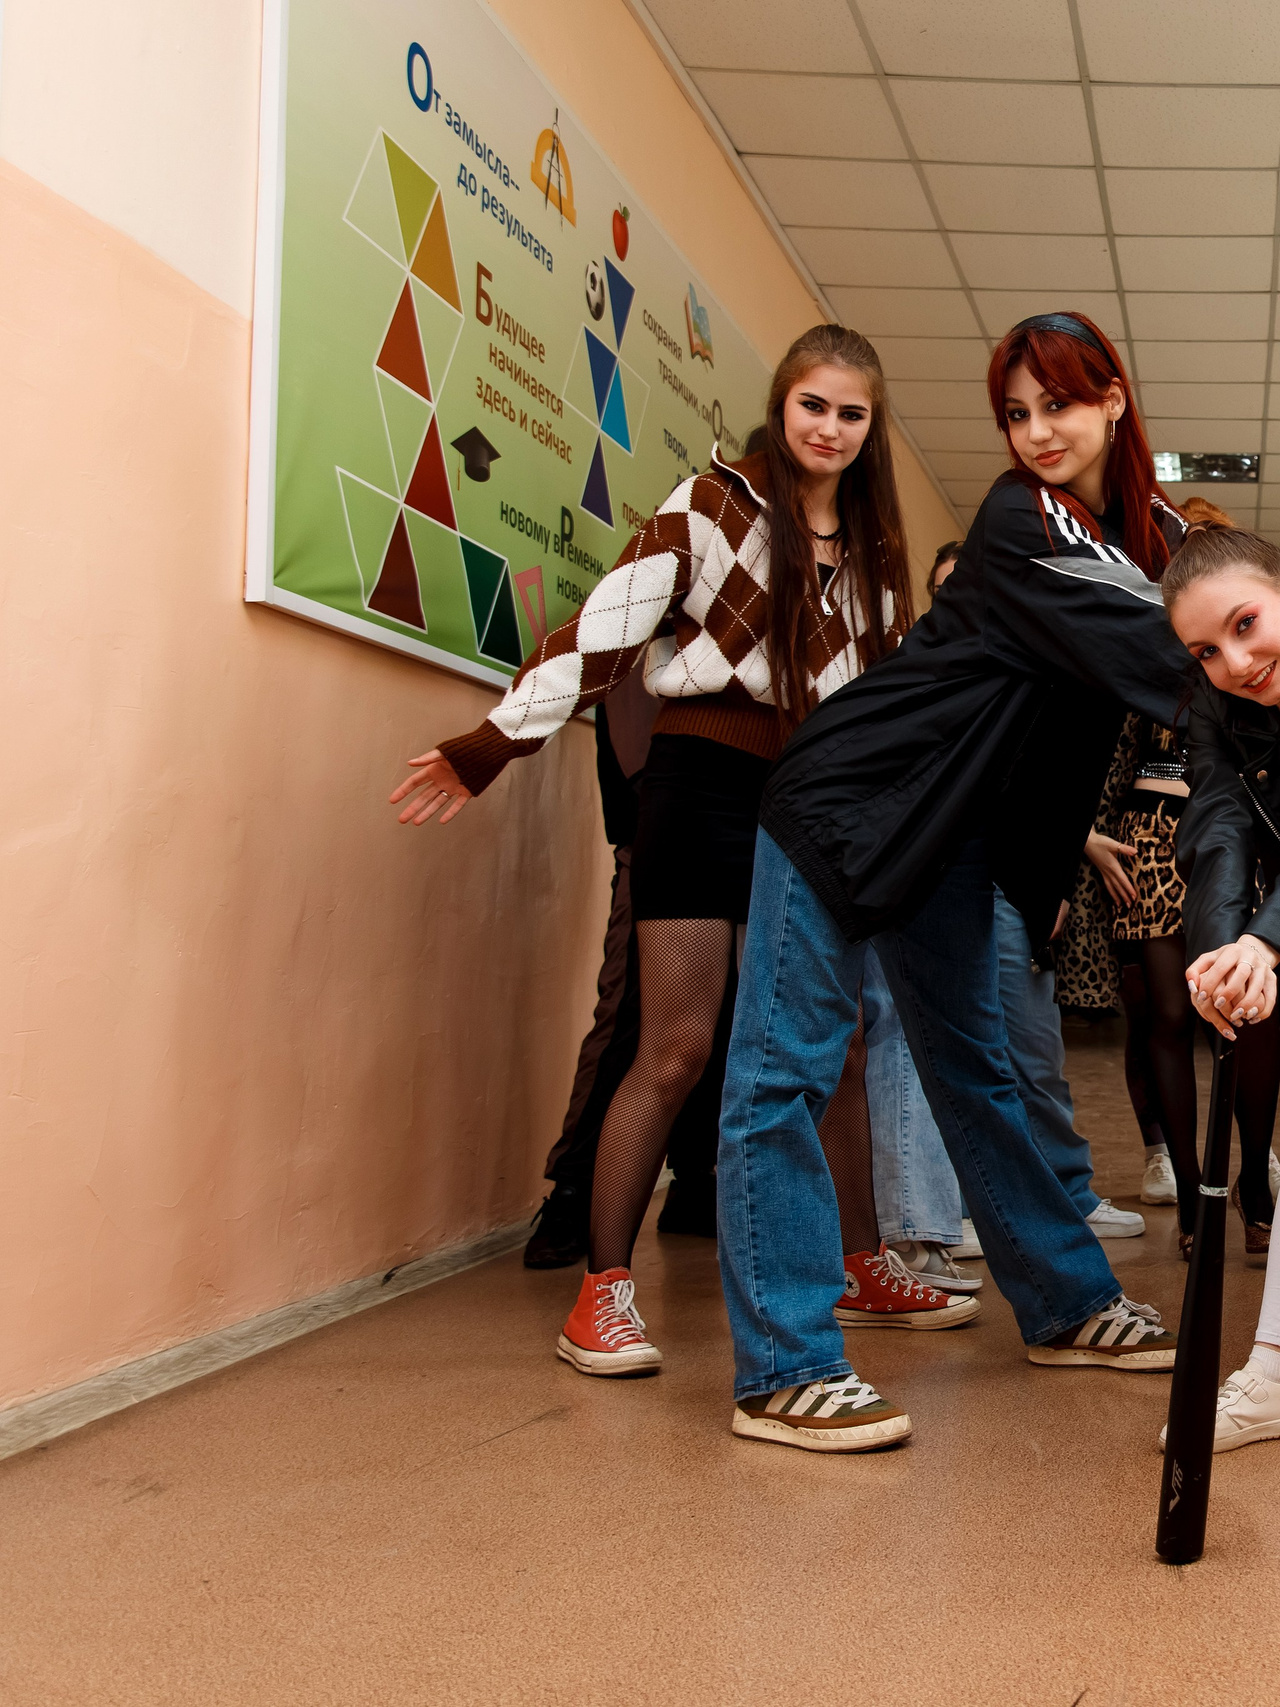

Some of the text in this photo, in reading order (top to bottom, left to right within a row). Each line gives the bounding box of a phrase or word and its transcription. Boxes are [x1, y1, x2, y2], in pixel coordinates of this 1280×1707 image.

[407, 41, 442, 113] От
[457, 162, 554, 274] до результата
[475, 261, 546, 364] Будущее
[643, 308, 683, 364] сохраняя
[489, 342, 564, 419] начинается
[658, 357, 701, 418] традиции,
[476, 376, 573, 465] здесь и сейчас
[663, 427, 690, 470] твори,
[500, 500, 551, 554] новому
[556, 575, 592, 605] новы
